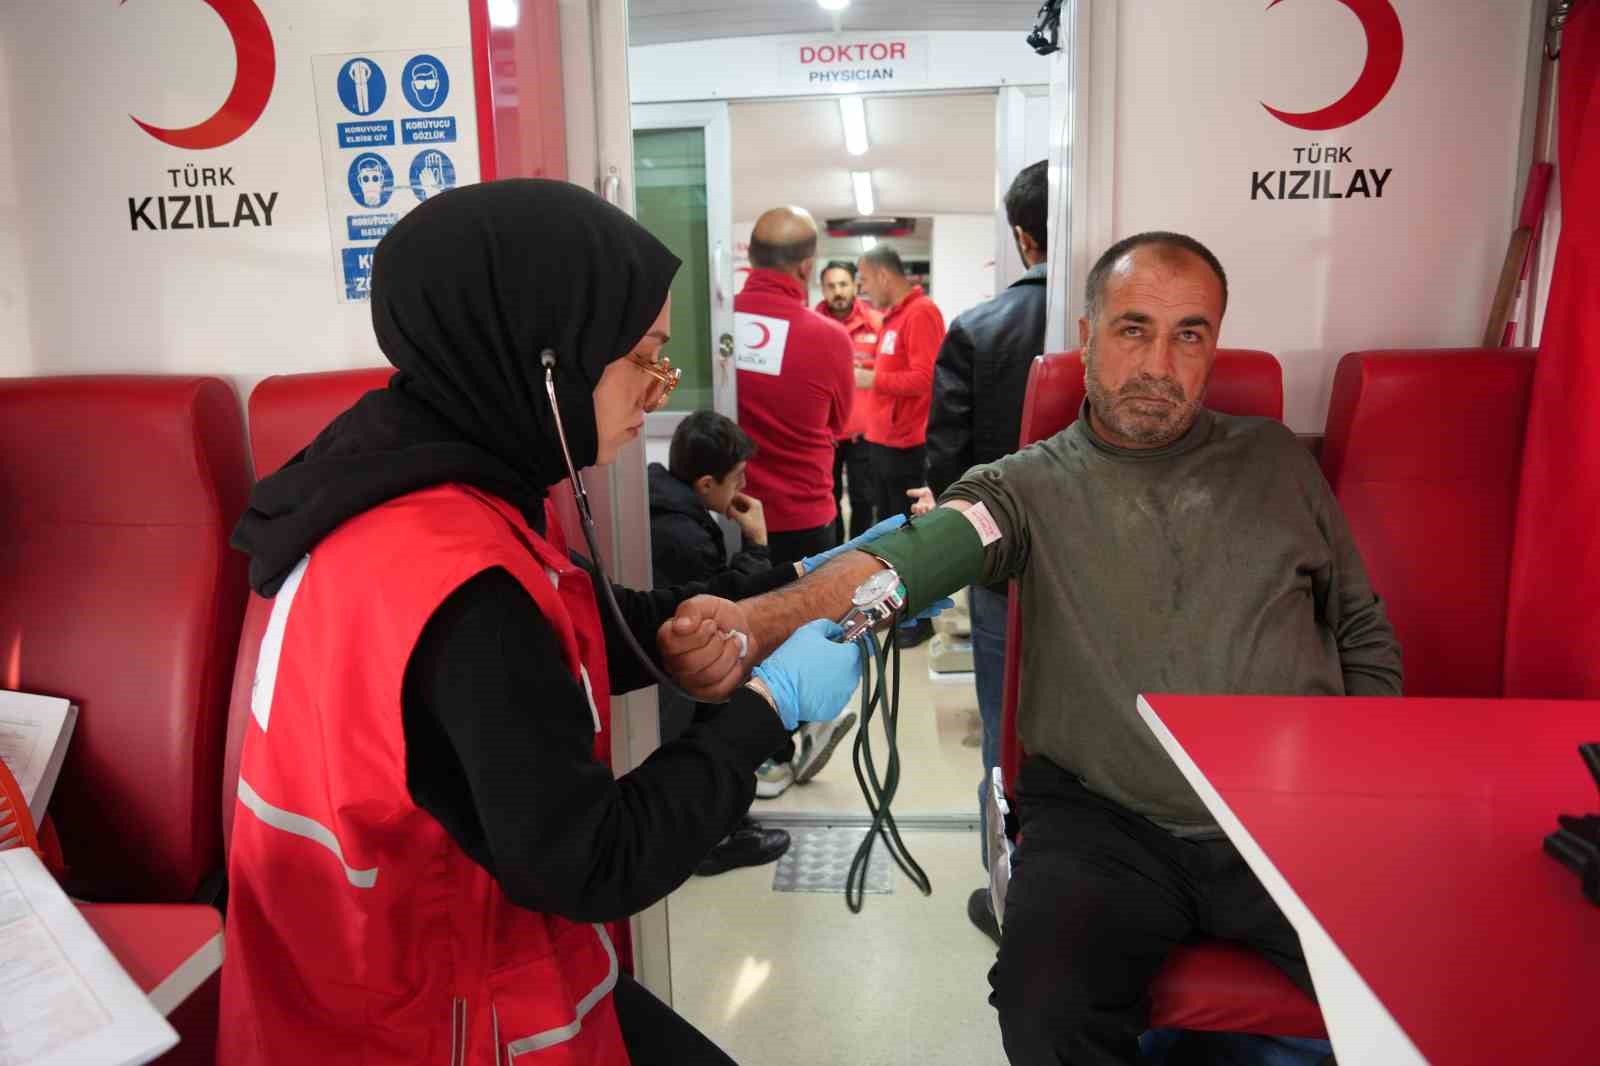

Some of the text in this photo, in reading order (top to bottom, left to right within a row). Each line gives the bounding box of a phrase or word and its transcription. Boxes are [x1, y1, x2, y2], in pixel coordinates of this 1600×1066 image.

[800, 42, 906, 64] DOKTOR
[809, 67, 894, 82] PHYSICIAN
[405, 119, 450, 130] KORUYUCU
[1292, 143, 1353, 164] TÜRK
[167, 163, 235, 188] TÜRK
[1250, 168, 1393, 200] KIZILAY
[128, 192, 279, 231] KIZILAY
